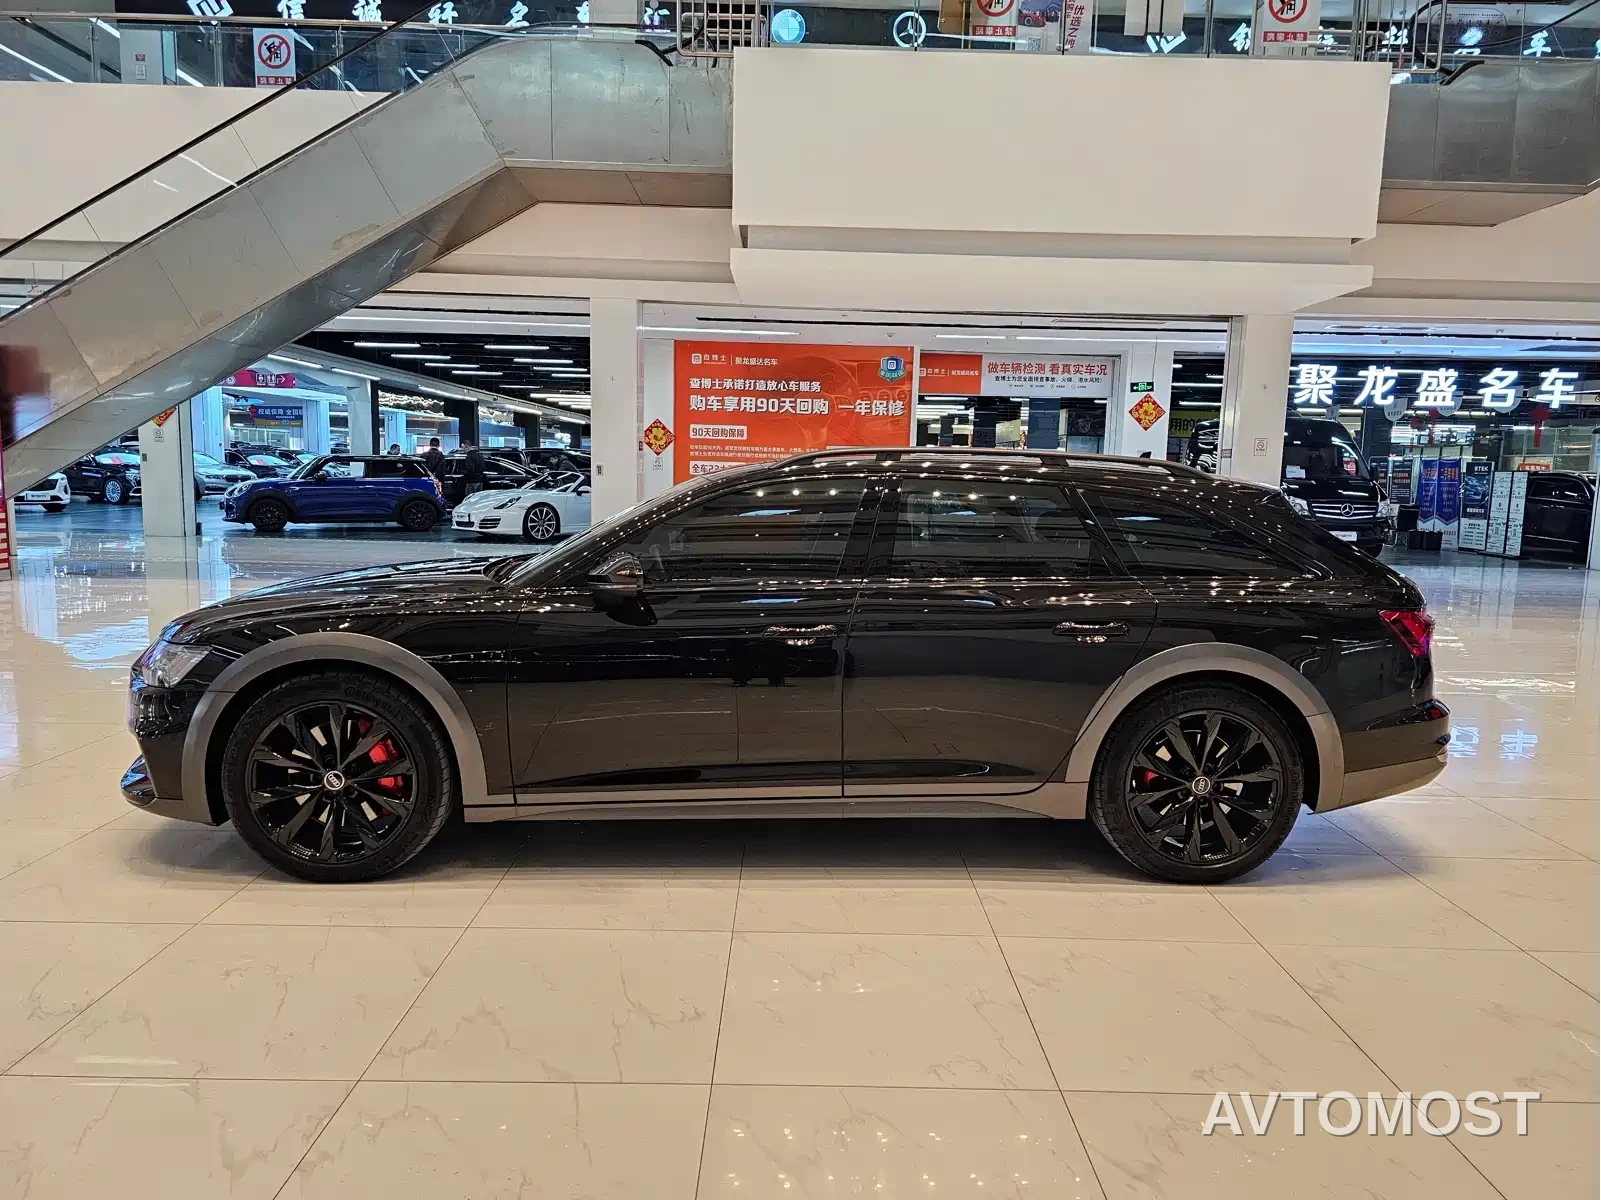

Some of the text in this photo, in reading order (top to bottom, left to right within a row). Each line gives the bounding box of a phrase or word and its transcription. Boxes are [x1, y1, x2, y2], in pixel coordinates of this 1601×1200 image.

[987, 361, 1107, 376] 做车辆检测 看真实车况
[689, 378, 821, 392] 查博士承诺打造放心车服务
[1294, 363, 1580, 409] 聚龙盛名车
[689, 395, 905, 416] 购车享用90天回购 一年保修
[692, 427, 747, 438] 90天回购保障
